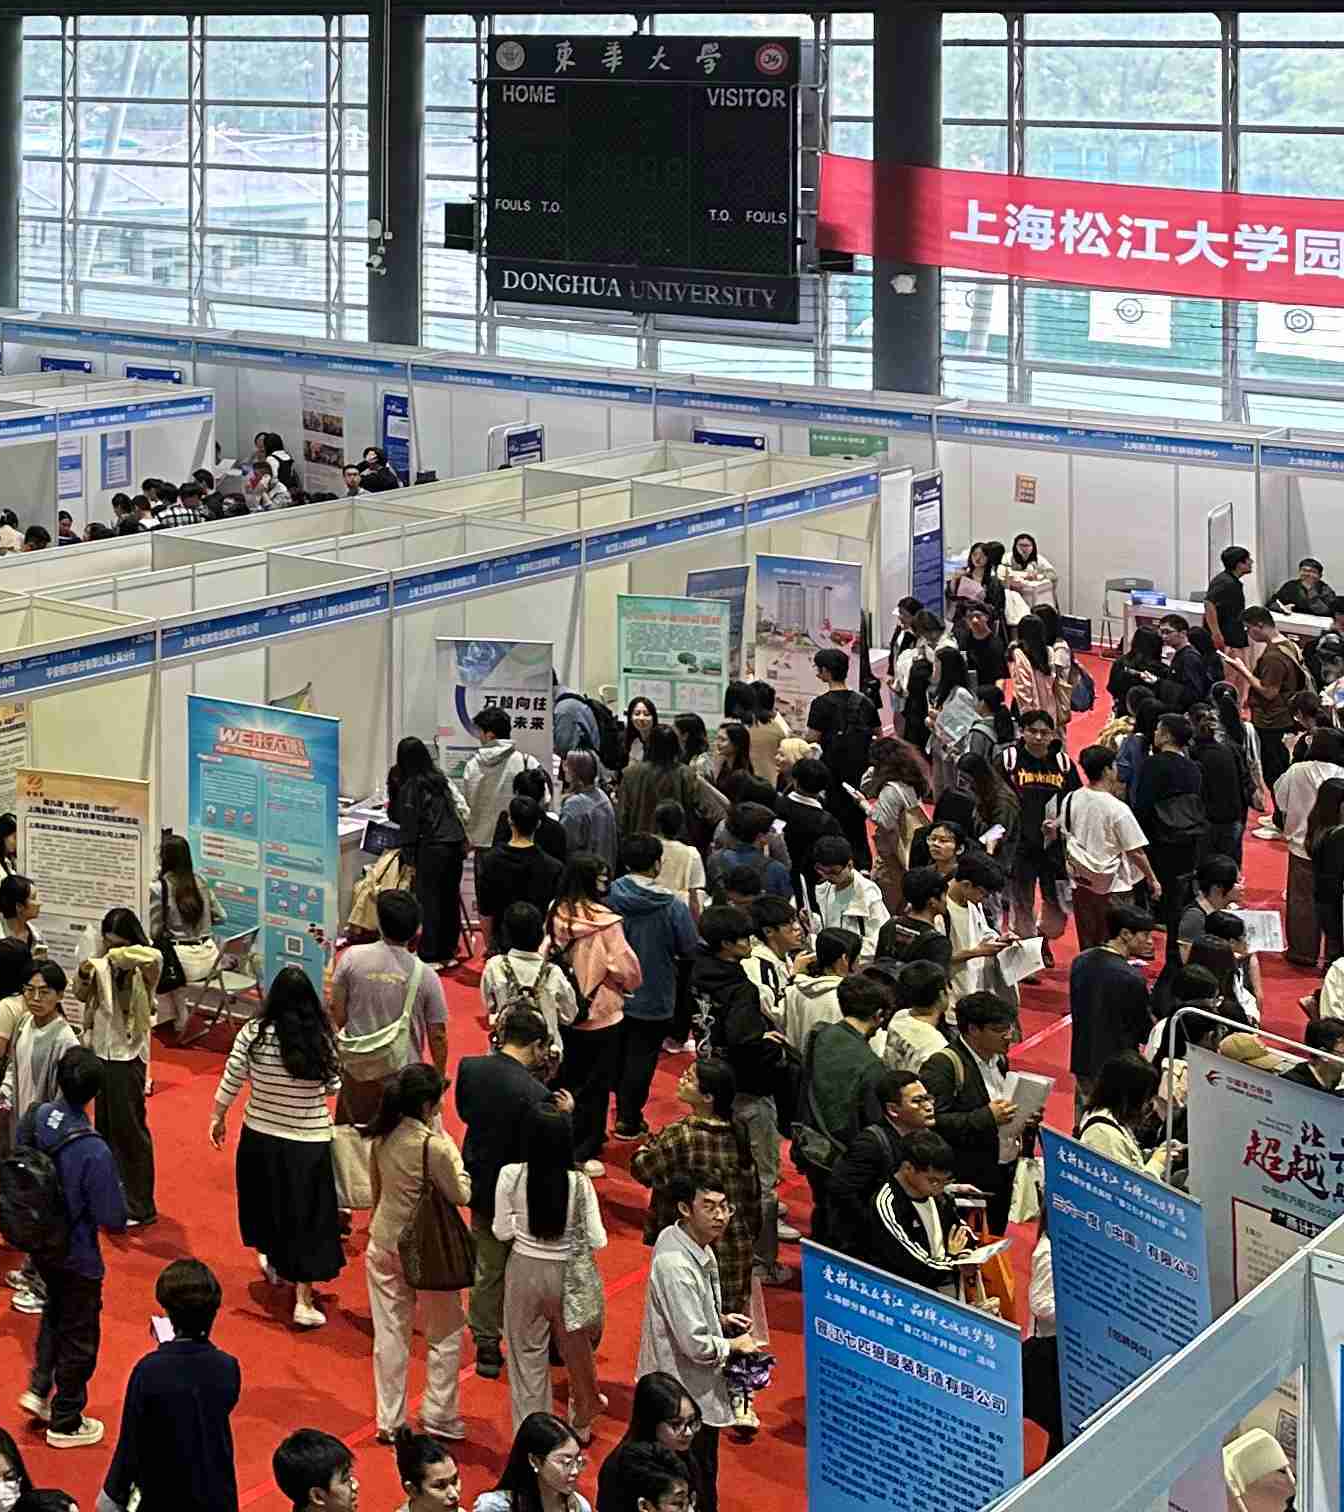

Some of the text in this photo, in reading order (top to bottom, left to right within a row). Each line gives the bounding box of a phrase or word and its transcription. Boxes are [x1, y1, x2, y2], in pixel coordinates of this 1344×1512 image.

[502, 85, 557, 104] HOME
[707, 88, 787, 109] VISITOR
[495, 199, 531, 212] FOULS
[746, 210, 787, 225] FOULS
[950, 198, 1344, 277] 上海松江大学园
[502, 270, 778, 310] DONGHUA UNIVERSITY
[814, 1315, 1008, 1416] 晋江七匹狼服装制造有限公司
